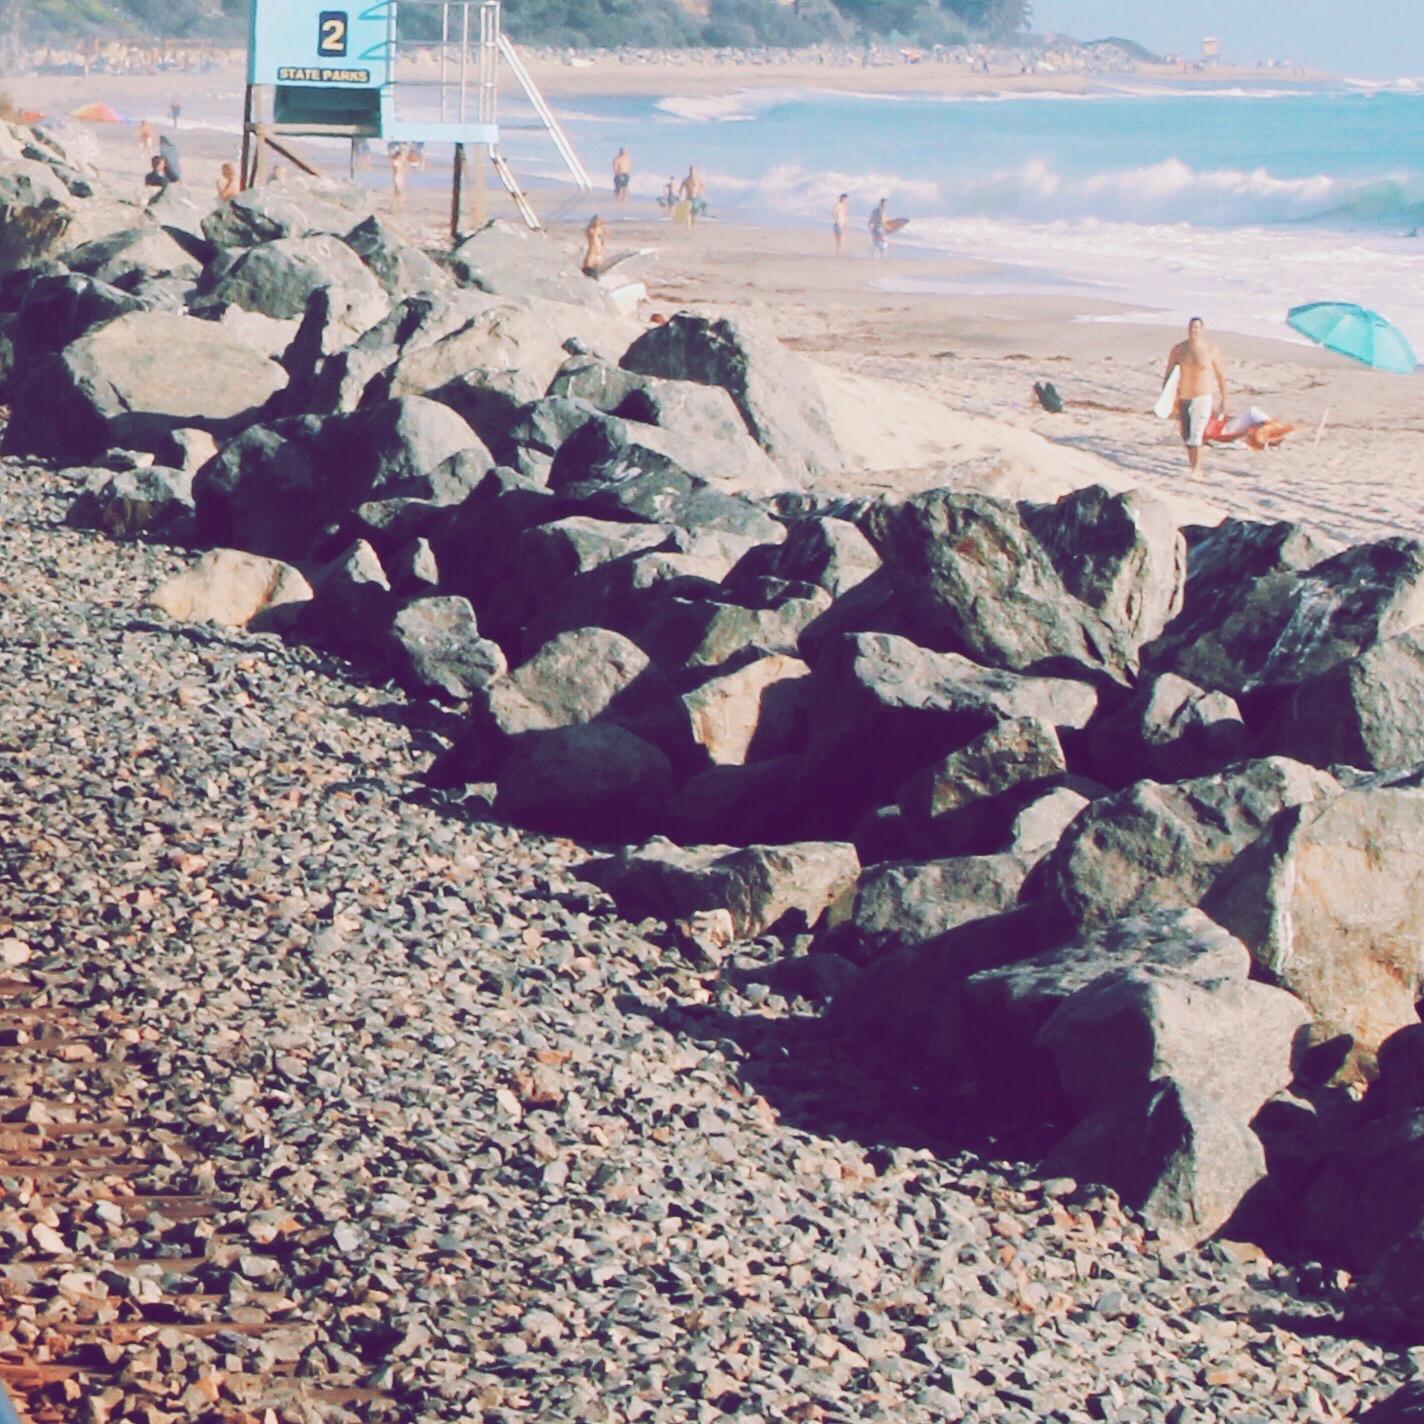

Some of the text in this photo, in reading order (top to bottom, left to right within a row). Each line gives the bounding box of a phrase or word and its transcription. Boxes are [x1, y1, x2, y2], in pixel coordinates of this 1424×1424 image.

[321, 19, 345, 51] 2
[279, 68, 368, 82] STATE PARKS
